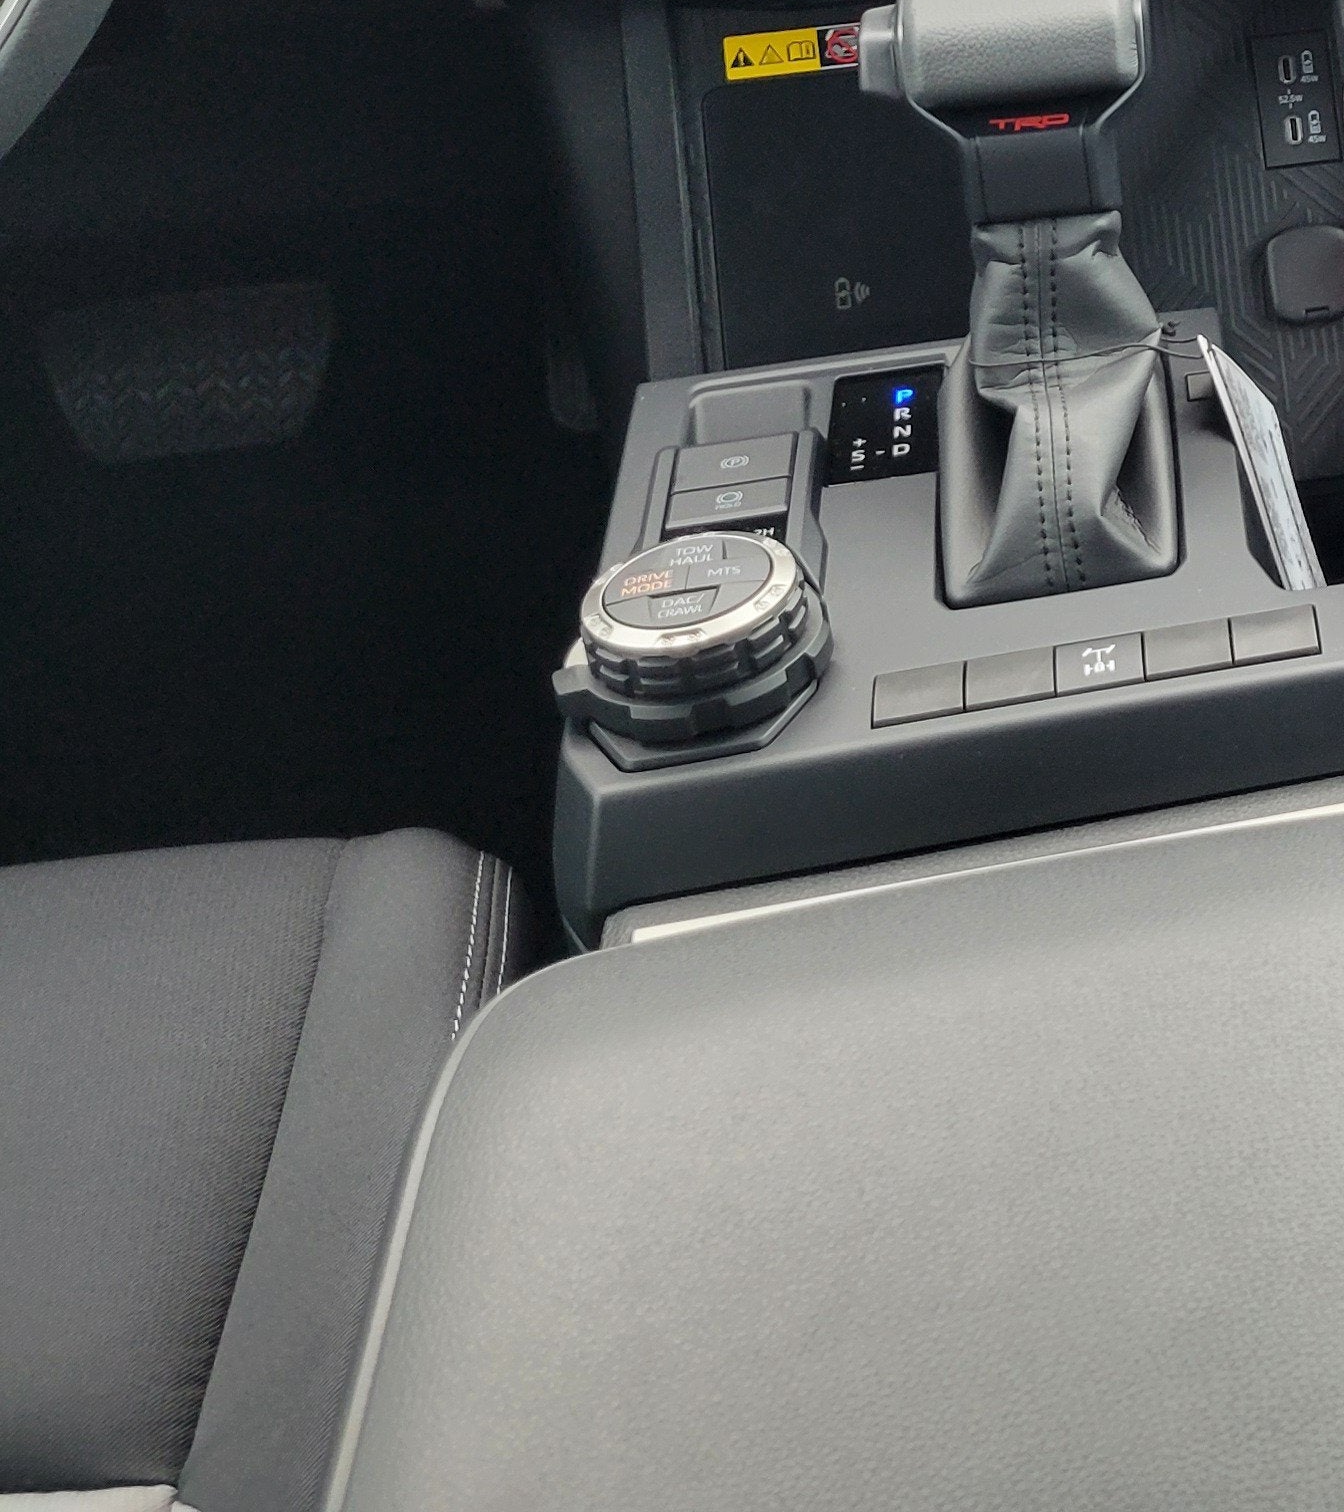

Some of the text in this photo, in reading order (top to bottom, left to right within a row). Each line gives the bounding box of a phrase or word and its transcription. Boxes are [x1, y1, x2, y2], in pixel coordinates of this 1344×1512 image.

[989, 113, 1069, 131] TRD
[896, 389, 913, 404] P
[893, 407, 912, 421] R
[893, 425, 912, 439] N
[851, 450, 865, 463] S
[892, 443, 910, 457] D
[716, 501, 742, 510] HOLD
[676, 544, 713, 555] TOW
[669, 554, 714, 566] HAUL
[624, 569, 674, 586] DRIVE
[707, 565, 741, 577] MTS
[621, 580, 672, 597] MODE
[662, 593, 704, 608] DAC/
[657, 605, 702, 618] CRAWL
